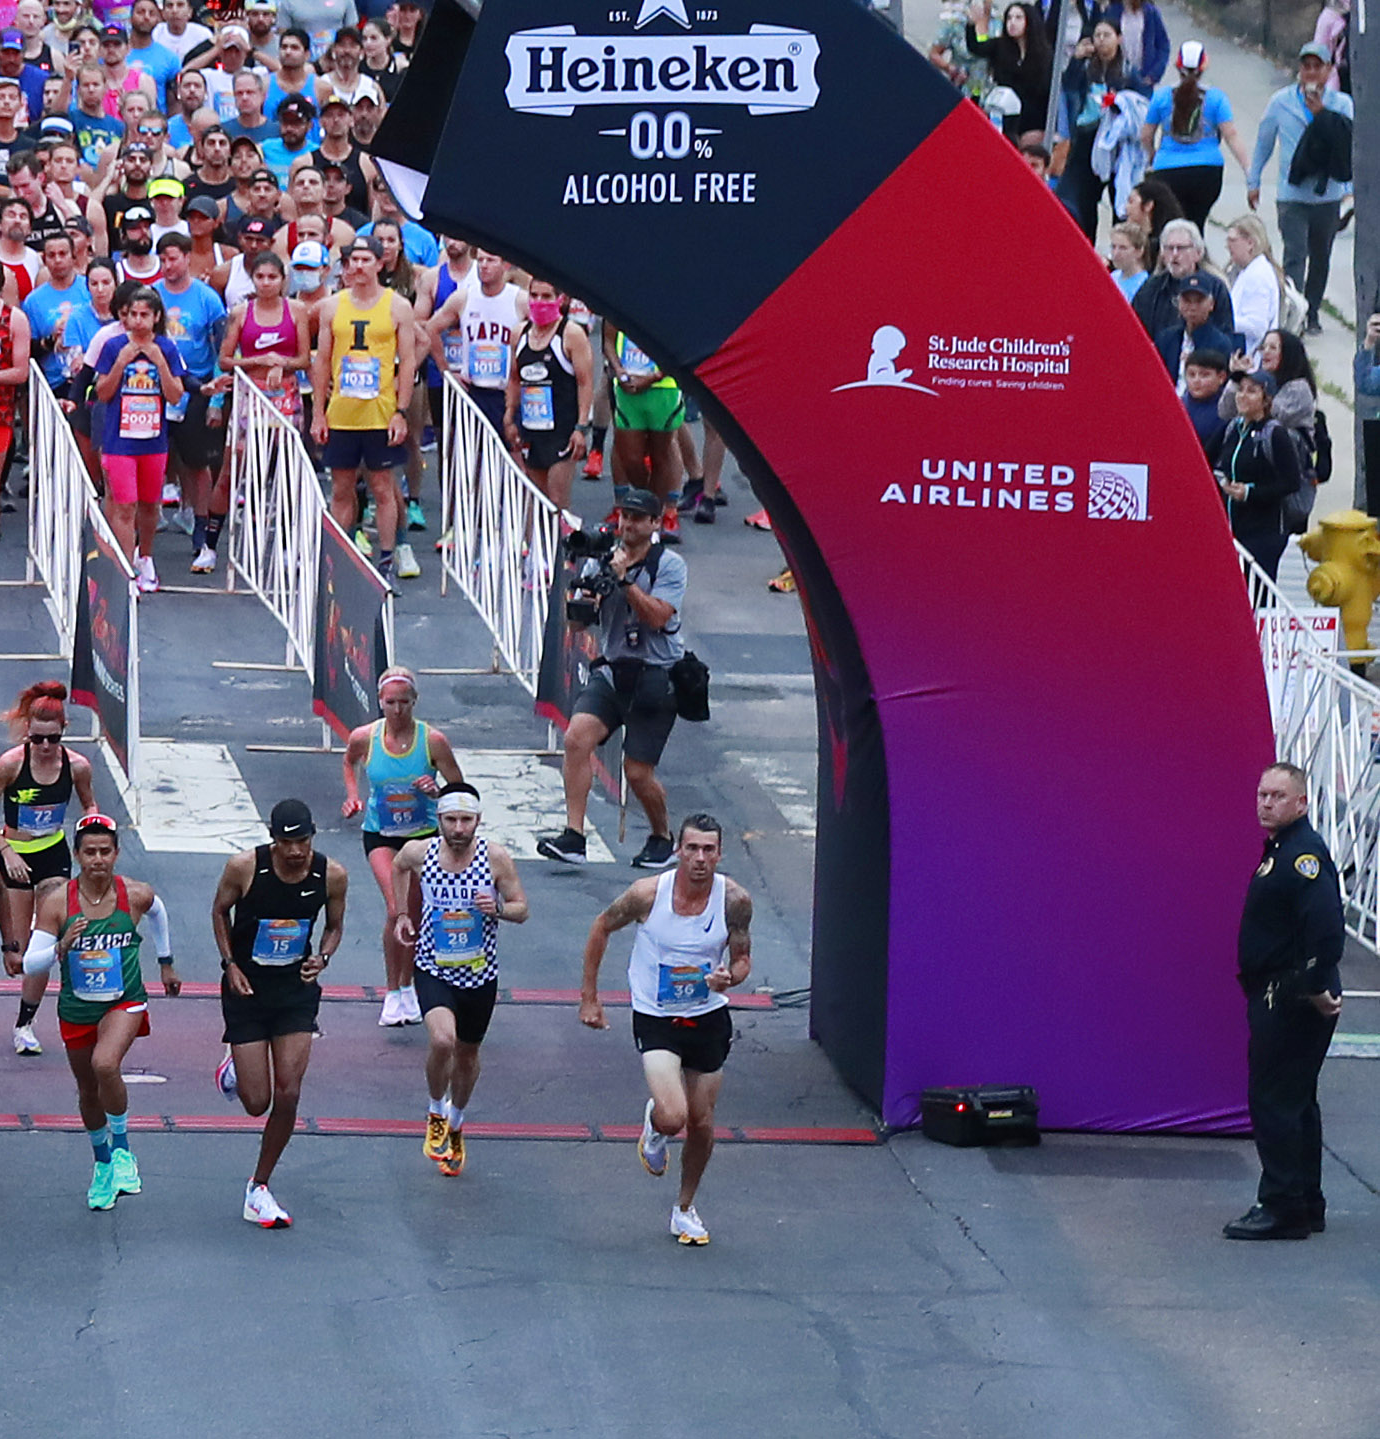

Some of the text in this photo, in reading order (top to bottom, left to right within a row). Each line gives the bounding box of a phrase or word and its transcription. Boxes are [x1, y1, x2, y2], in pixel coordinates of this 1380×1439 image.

[608, 9, 719, 23] EST. 1873
[524, 44, 799, 93] Heineken
[562, 172, 757, 205] ALCOHOL FREE
[349, 319, 371, 351] I
[950, 335, 988, 354] Jude
[989, 336, 1070, 357] Children's
[927, 353, 1071, 378] Research Hospital
[921, 458, 1075, 487] UNITED
[880, 482, 1075, 513] AIRLINES
[33, 809, 54, 824] 72
[271, 938, 290, 952] 15
[447, 932, 469, 946] 28
[84, 971, 108, 986] 24
